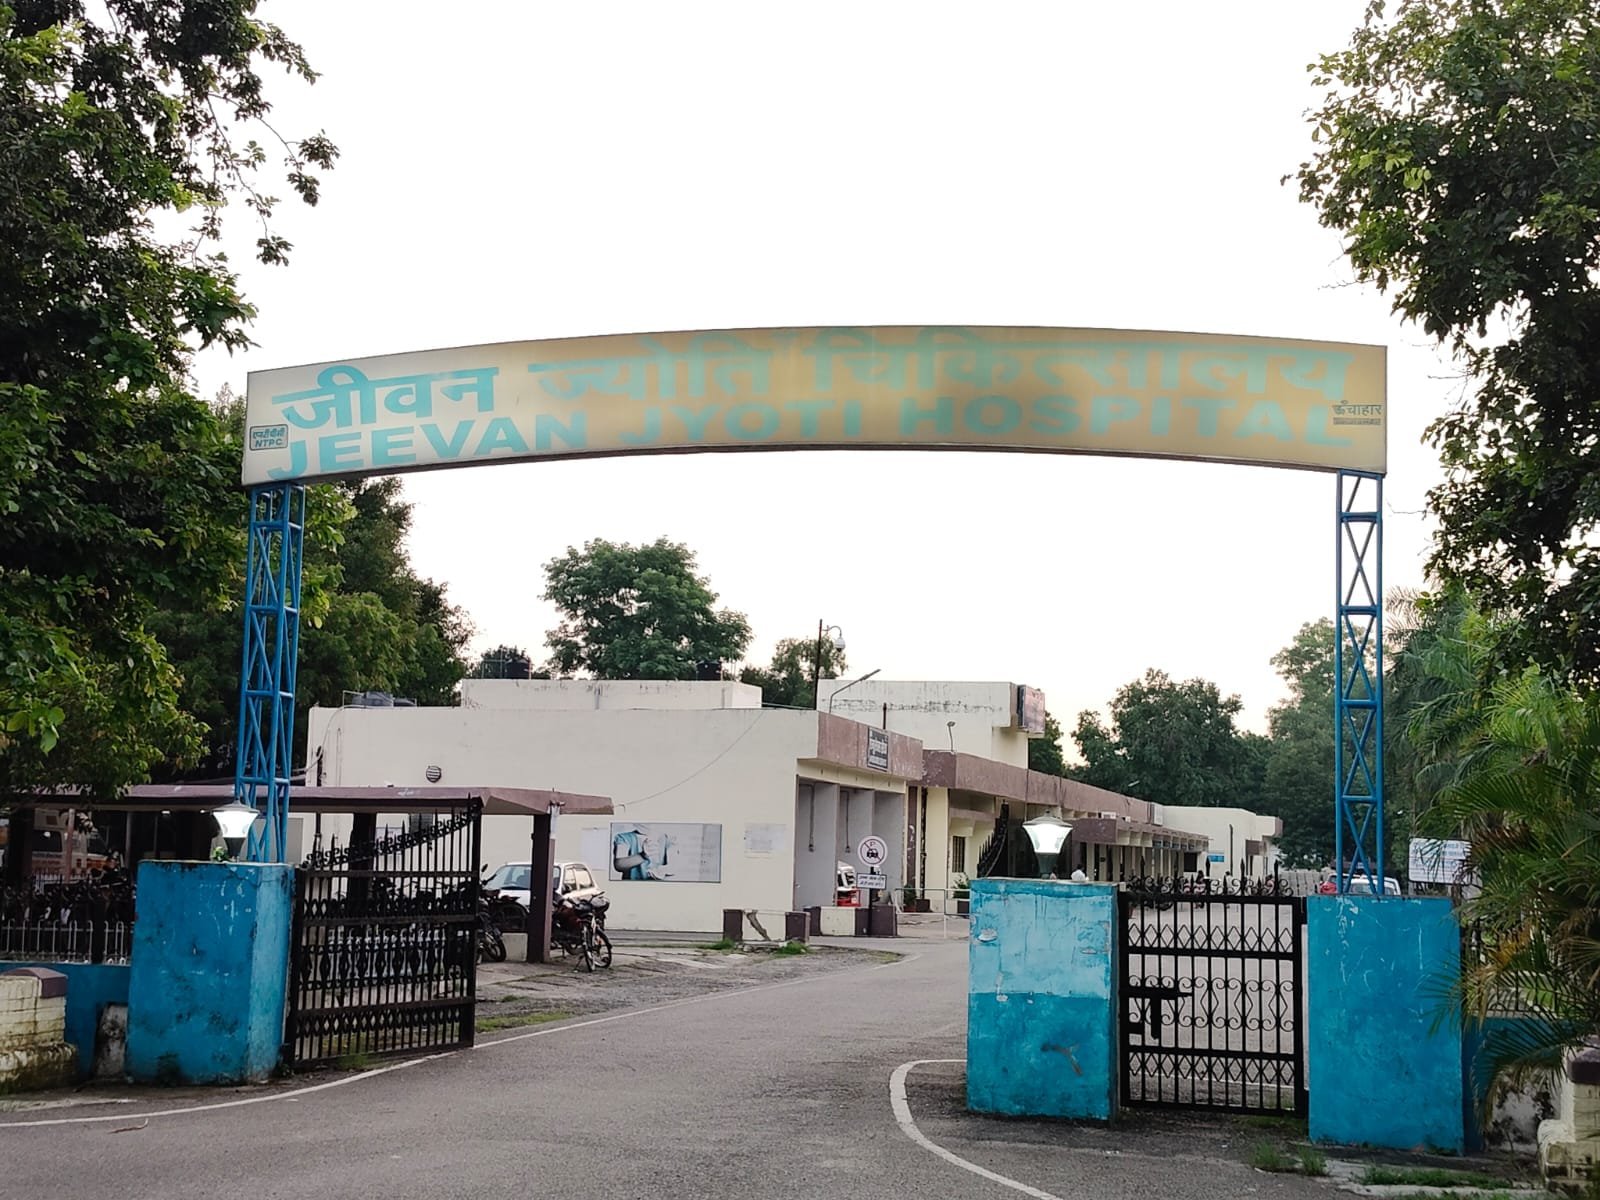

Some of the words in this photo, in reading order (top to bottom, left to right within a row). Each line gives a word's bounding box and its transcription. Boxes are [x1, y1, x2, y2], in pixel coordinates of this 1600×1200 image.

[271, 364, 499, 429] जीवन
[527, 330, 775, 400] ज्योति
[801, 326, 1355, 401] चिकित्सालय
[255, 438, 283, 448] NTPC
[267, 410, 587, 480] JEEVAN
[619, 399, 863, 444] JYOTI
[900, 394, 1355, 447] HOSPITAL
